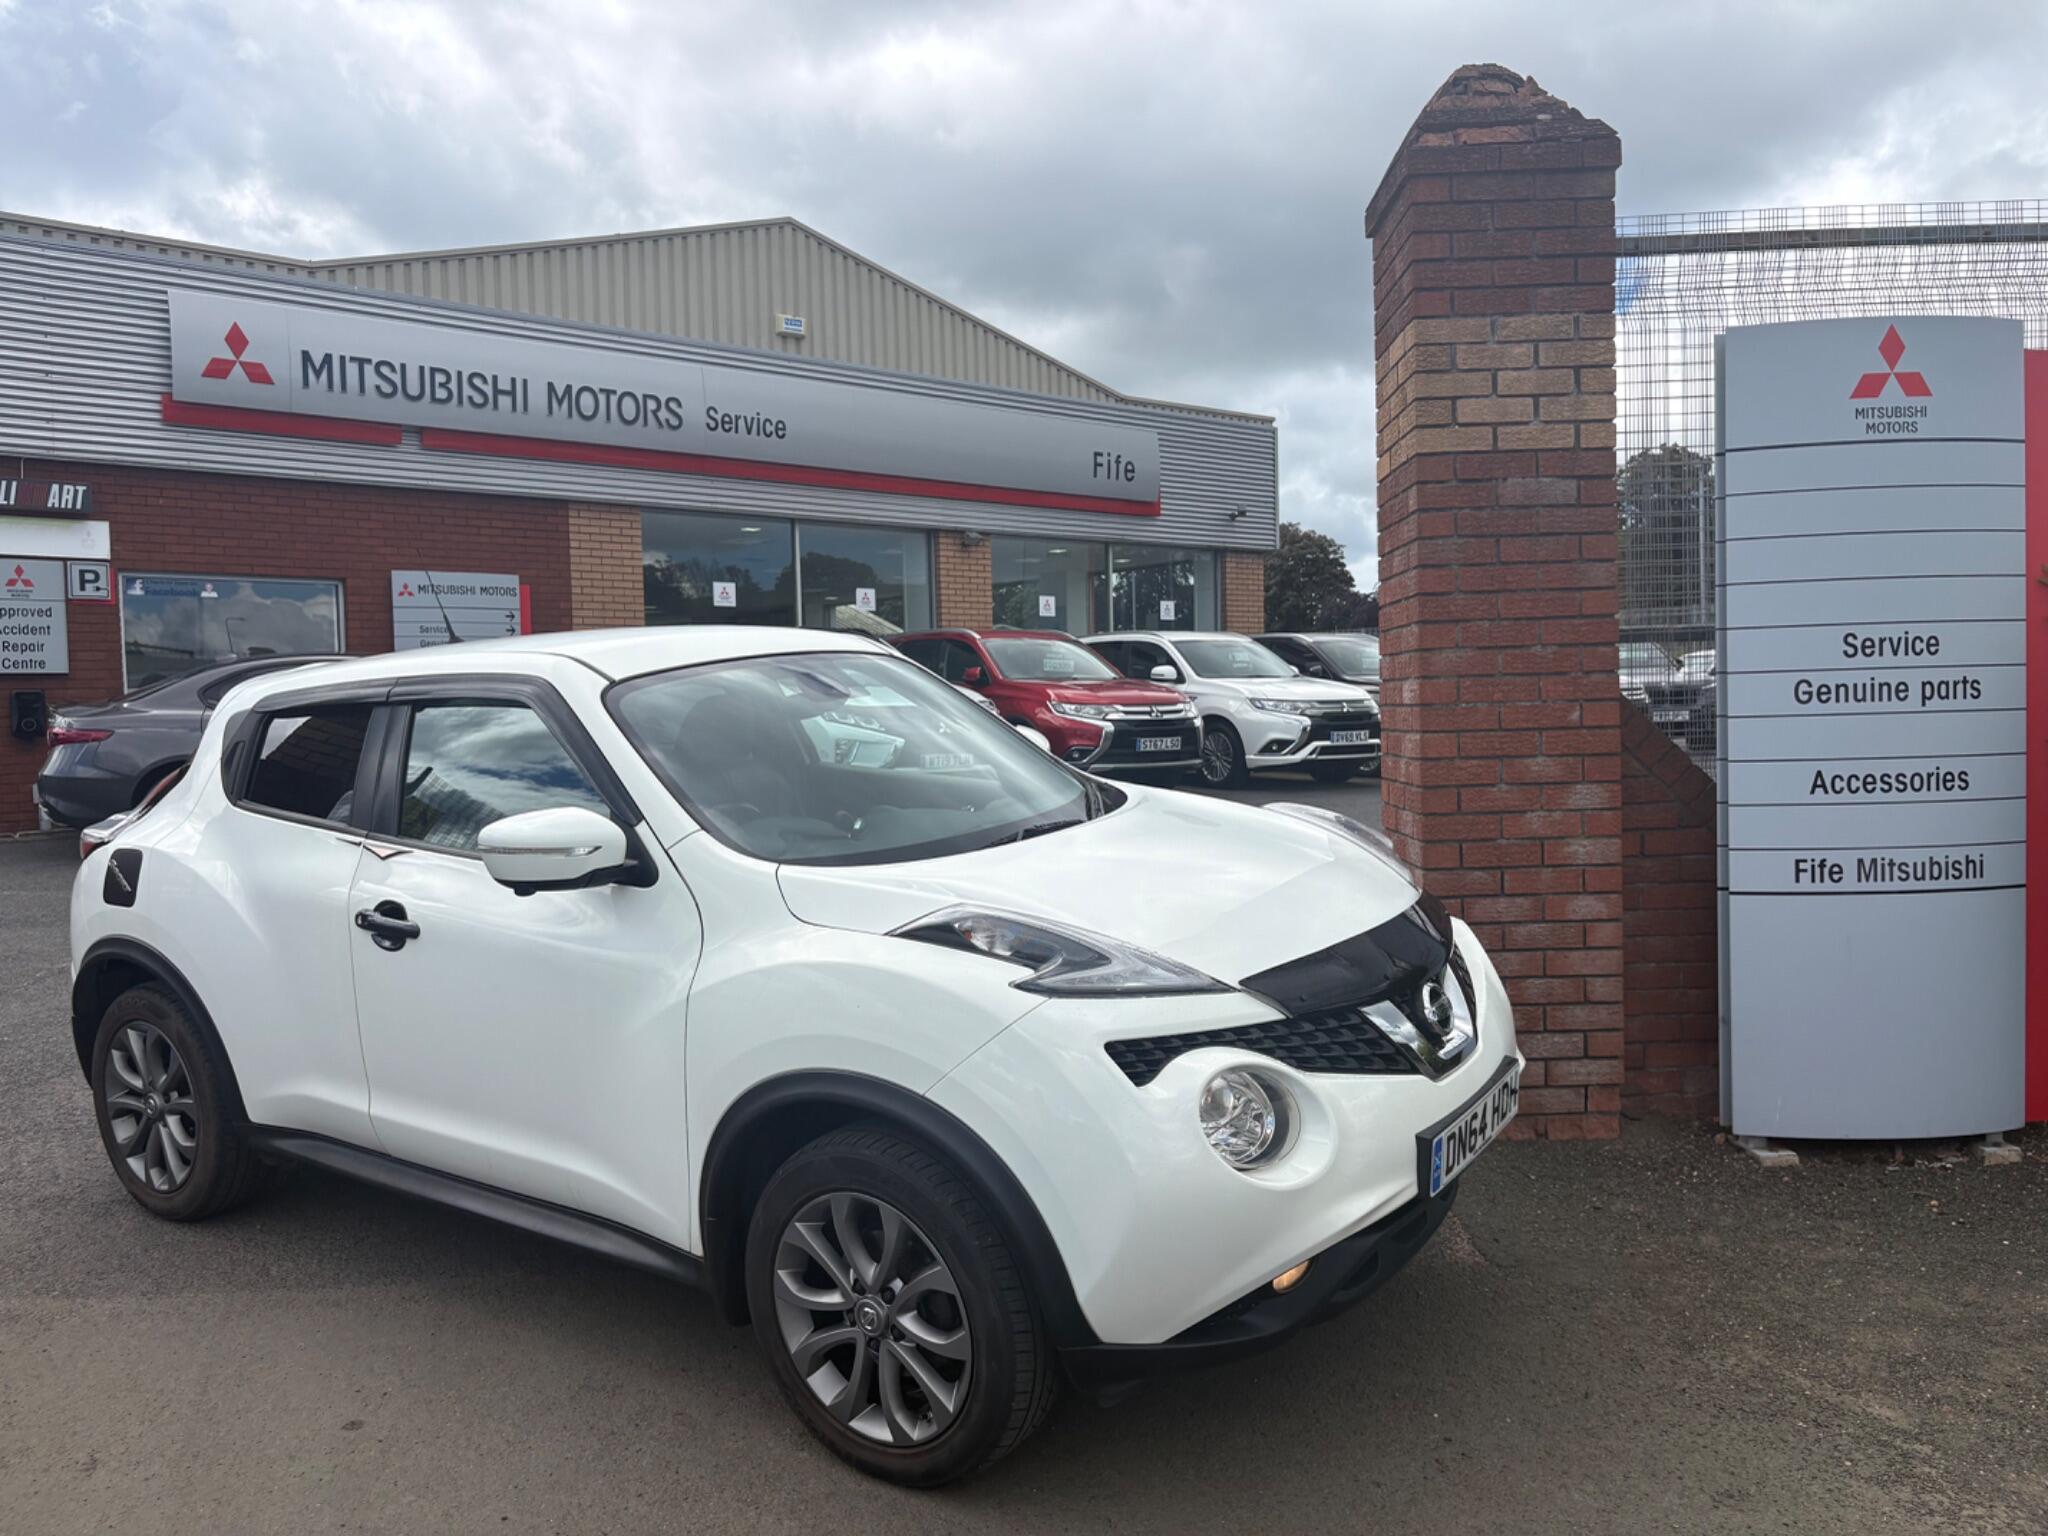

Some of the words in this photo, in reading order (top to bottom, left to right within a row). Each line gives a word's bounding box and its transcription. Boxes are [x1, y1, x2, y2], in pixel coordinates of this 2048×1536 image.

[301, 350, 529, 415] MITSUBISHI
[547, 381, 684, 431] MOTORS
[705, 406, 787, 439] Service
[1855, 405, 1927, 420] MITSUBISHI
[1865, 421, 1919, 434] MOTORS
[1093, 451, 1135, 482] Fife
[47, 483, 87, 510] ART
[78, 569, 100, 592] P
[418, 583, 476, 596] MITSUBISHI
[480, 586, 518, 597] MOTORS
[0, 606, 52, 620] pproved
[0, 624, 51, 636] ccident
[2, 640, 45, 655] Repair
[1842, 631, 1940, 658] Service
[2, 658, 46, 670] Centre
[1794, 677, 1910, 705] Genuine
[1921, 676, 1982, 707] parts
[1142, 738, 1163, 750] ST67
[1809, 766, 1970, 795] Accessories
[1794, 858, 1844, 884] Fife
[1856, 853, 1984, 883] Mitsubishi
[1445, 1102, 1488, 1176] DN64
[1491, 1070, 1518, 1132] HDH
